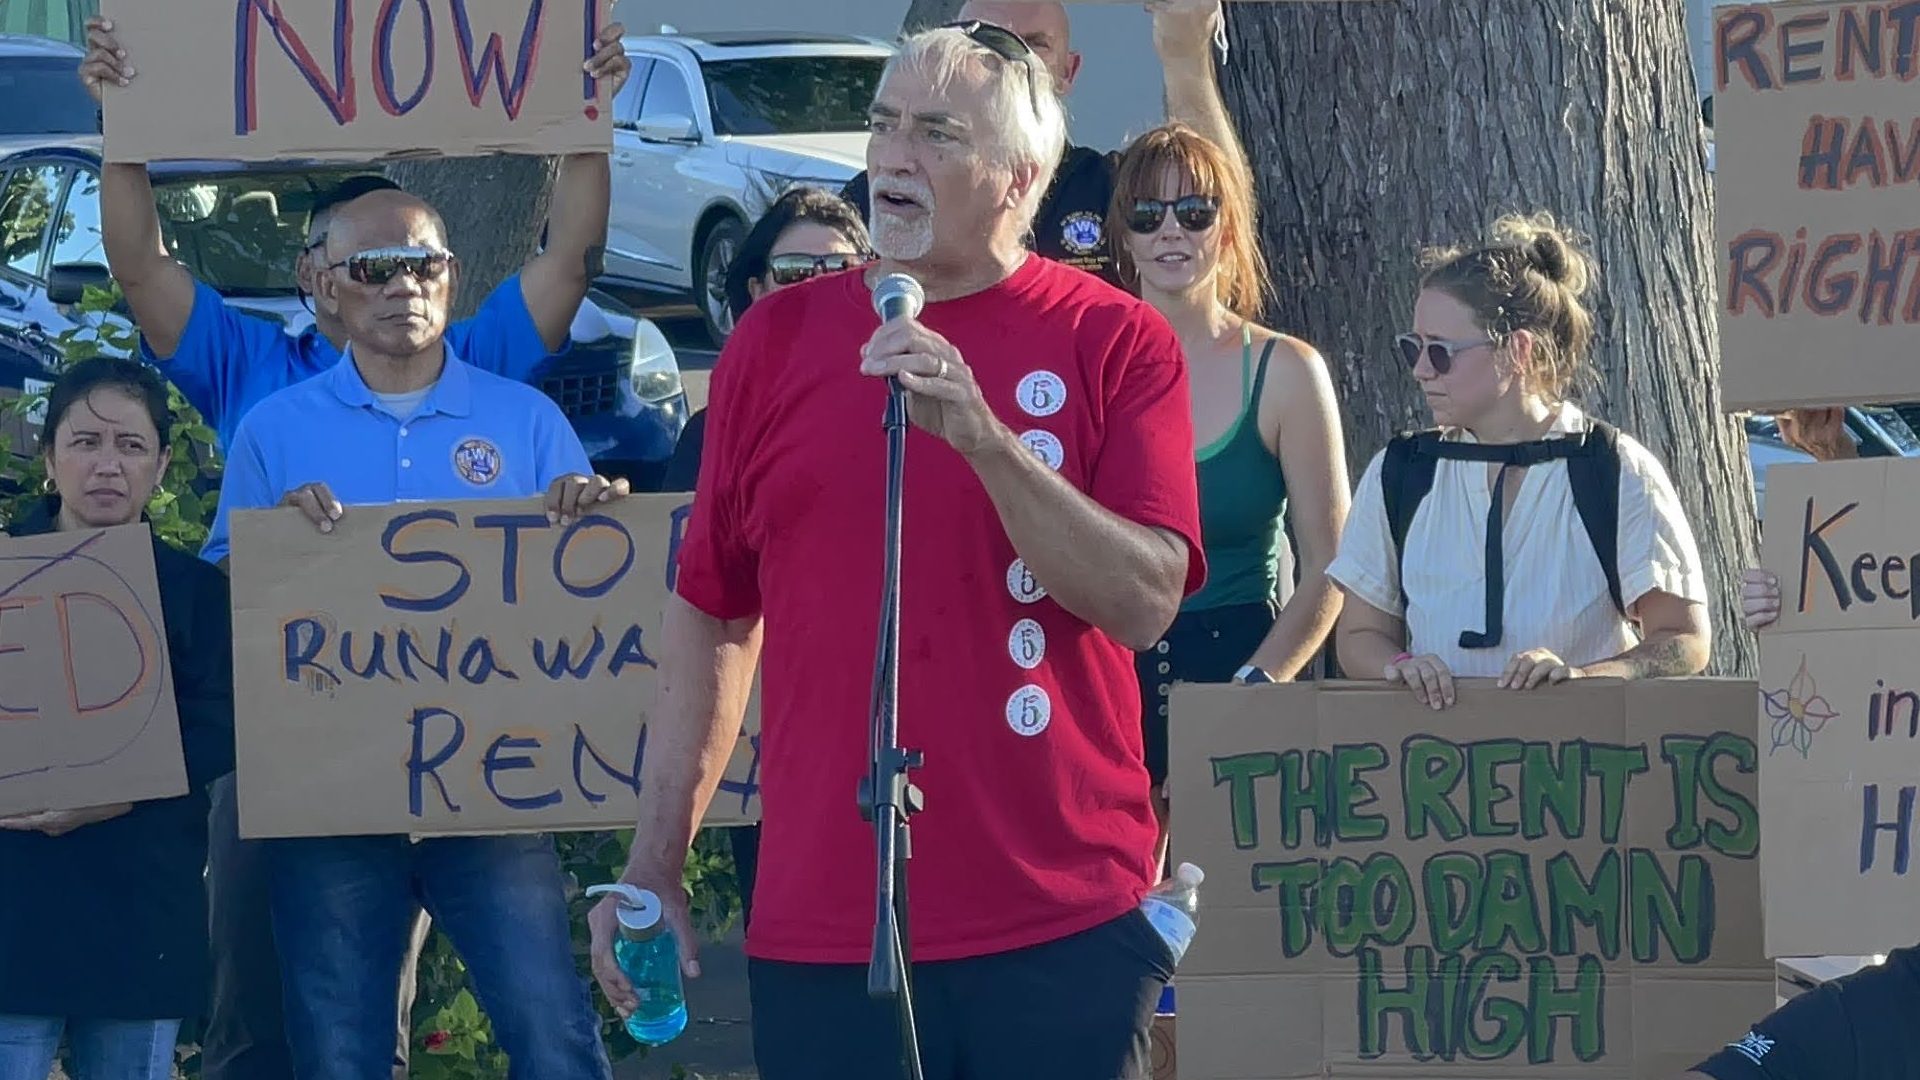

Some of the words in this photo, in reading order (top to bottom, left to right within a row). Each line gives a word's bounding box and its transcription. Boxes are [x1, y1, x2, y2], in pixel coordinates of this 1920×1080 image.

[1030, 379, 1053, 409] 5
[1211, 742, 1390, 850] THE
[1401, 733, 1649, 842] RENT
[1661, 731, 1760, 860] IS
[1252, 851, 1415, 959] TOO
[1423, 848, 1716, 963] DAMN
[1358, 946, 1606, 1064] HIGH
